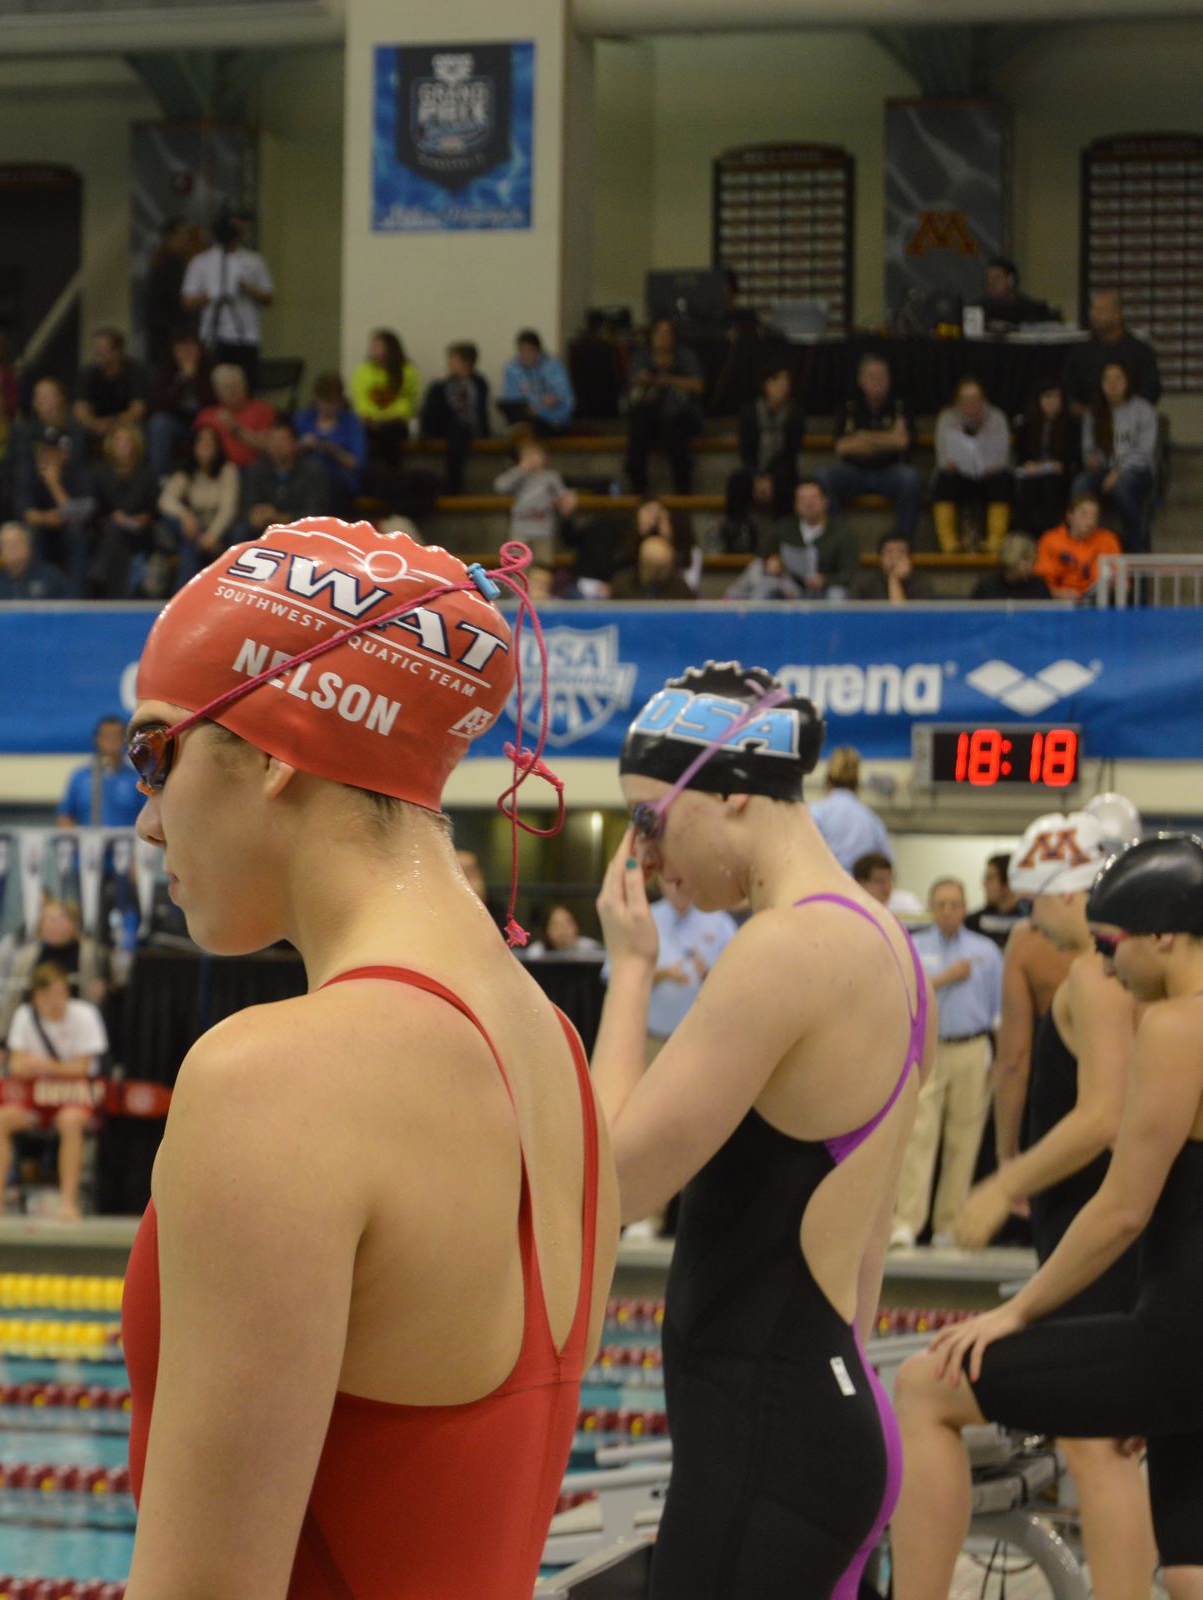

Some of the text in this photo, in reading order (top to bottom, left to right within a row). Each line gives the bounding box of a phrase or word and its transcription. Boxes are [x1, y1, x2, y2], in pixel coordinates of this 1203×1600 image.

[214, 585, 476, 697] SOUTHWEST QUATIC TEAM
[226, 546, 510, 673] SWAT
[232, 637, 402, 737] NELSON
[955, 729, 1077, 787] 18:18
[1017, 828, 1091, 868] M
